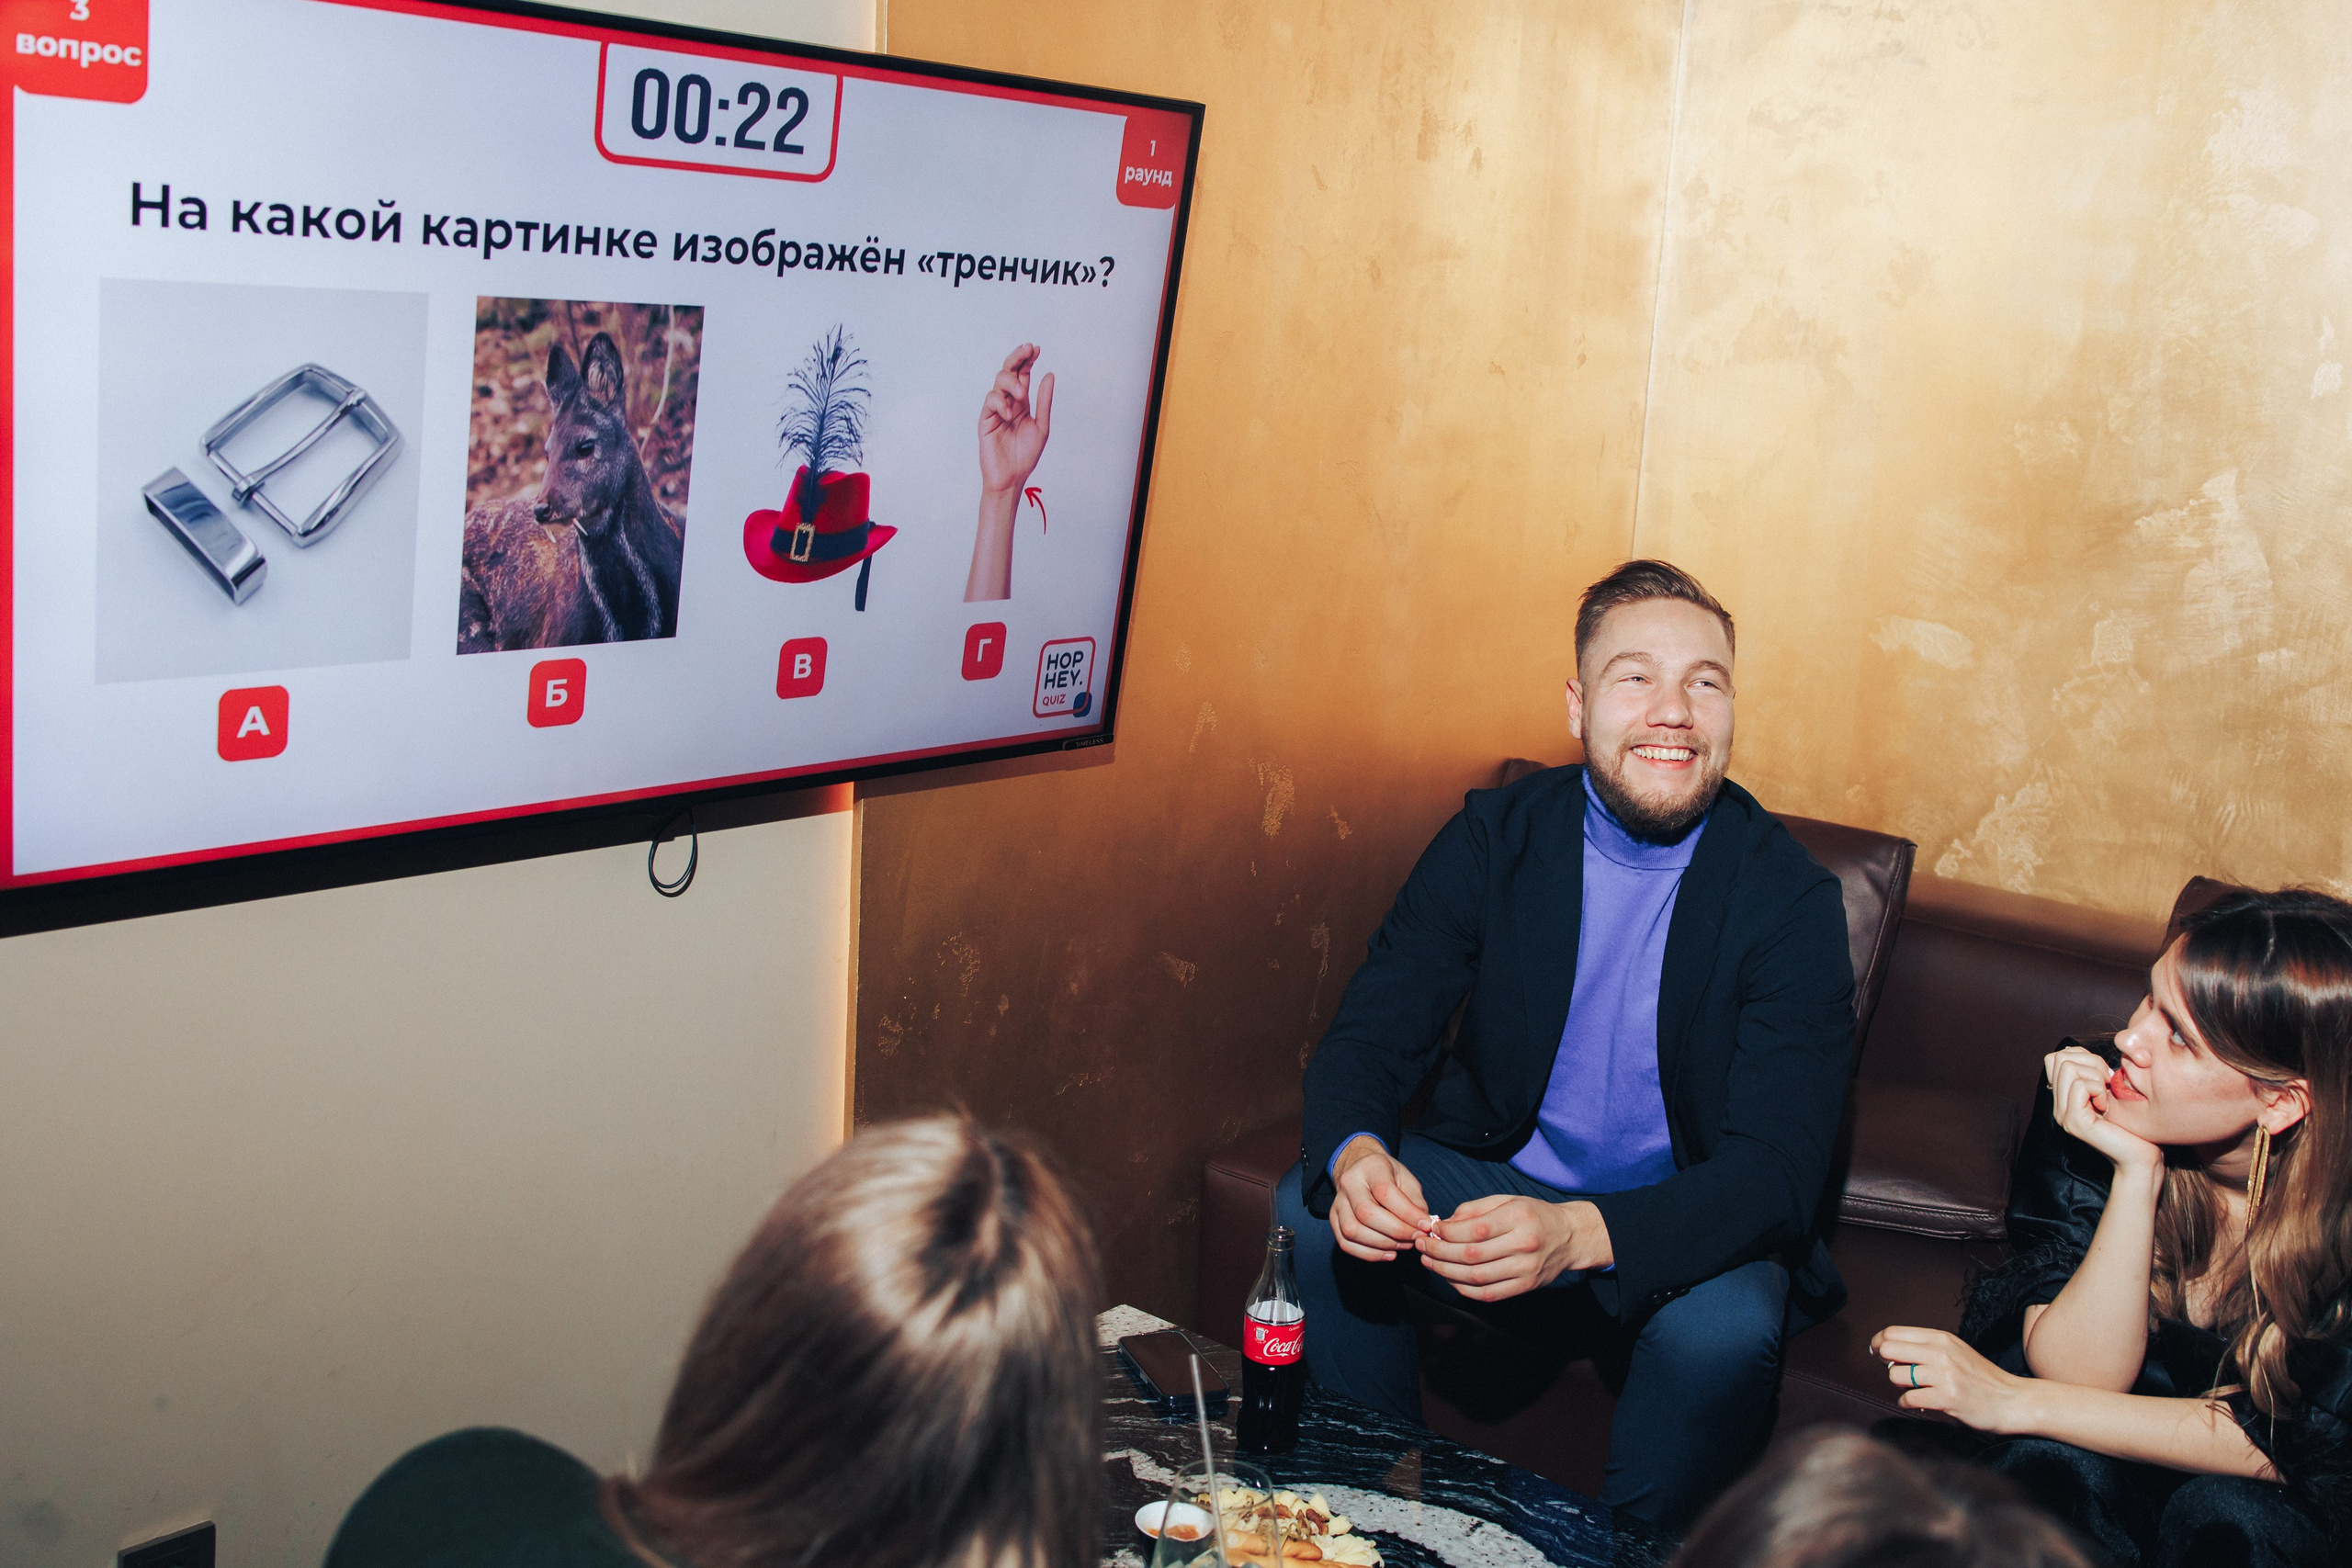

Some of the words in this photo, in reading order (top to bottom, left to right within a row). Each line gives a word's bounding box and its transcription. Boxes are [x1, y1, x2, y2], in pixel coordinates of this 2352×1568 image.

[69, 0, 90, 21] 3
[16, 32, 142, 69] вопрос
[631, 68, 809, 154] 00:22
[1150, 140, 1157, 157] 1
[1124, 165, 1173, 188] раунд
[131, 182, 208, 231] На
[232, 199, 401, 243] какой
[422, 214, 658, 260] картинке
[673, 228, 906, 277] изображён
[917, 252, 1115, 288] «тренчик»?
[977, 637, 992, 663] Г
[1046, 650, 1084, 671] HOP
[793, 653, 812, 680] В
[1044, 669, 1083, 690] HEY.
[545, 678, 569, 708] Б
[1042, 694, 1066, 706] QUIZ
[236, 705, 271, 739] А
